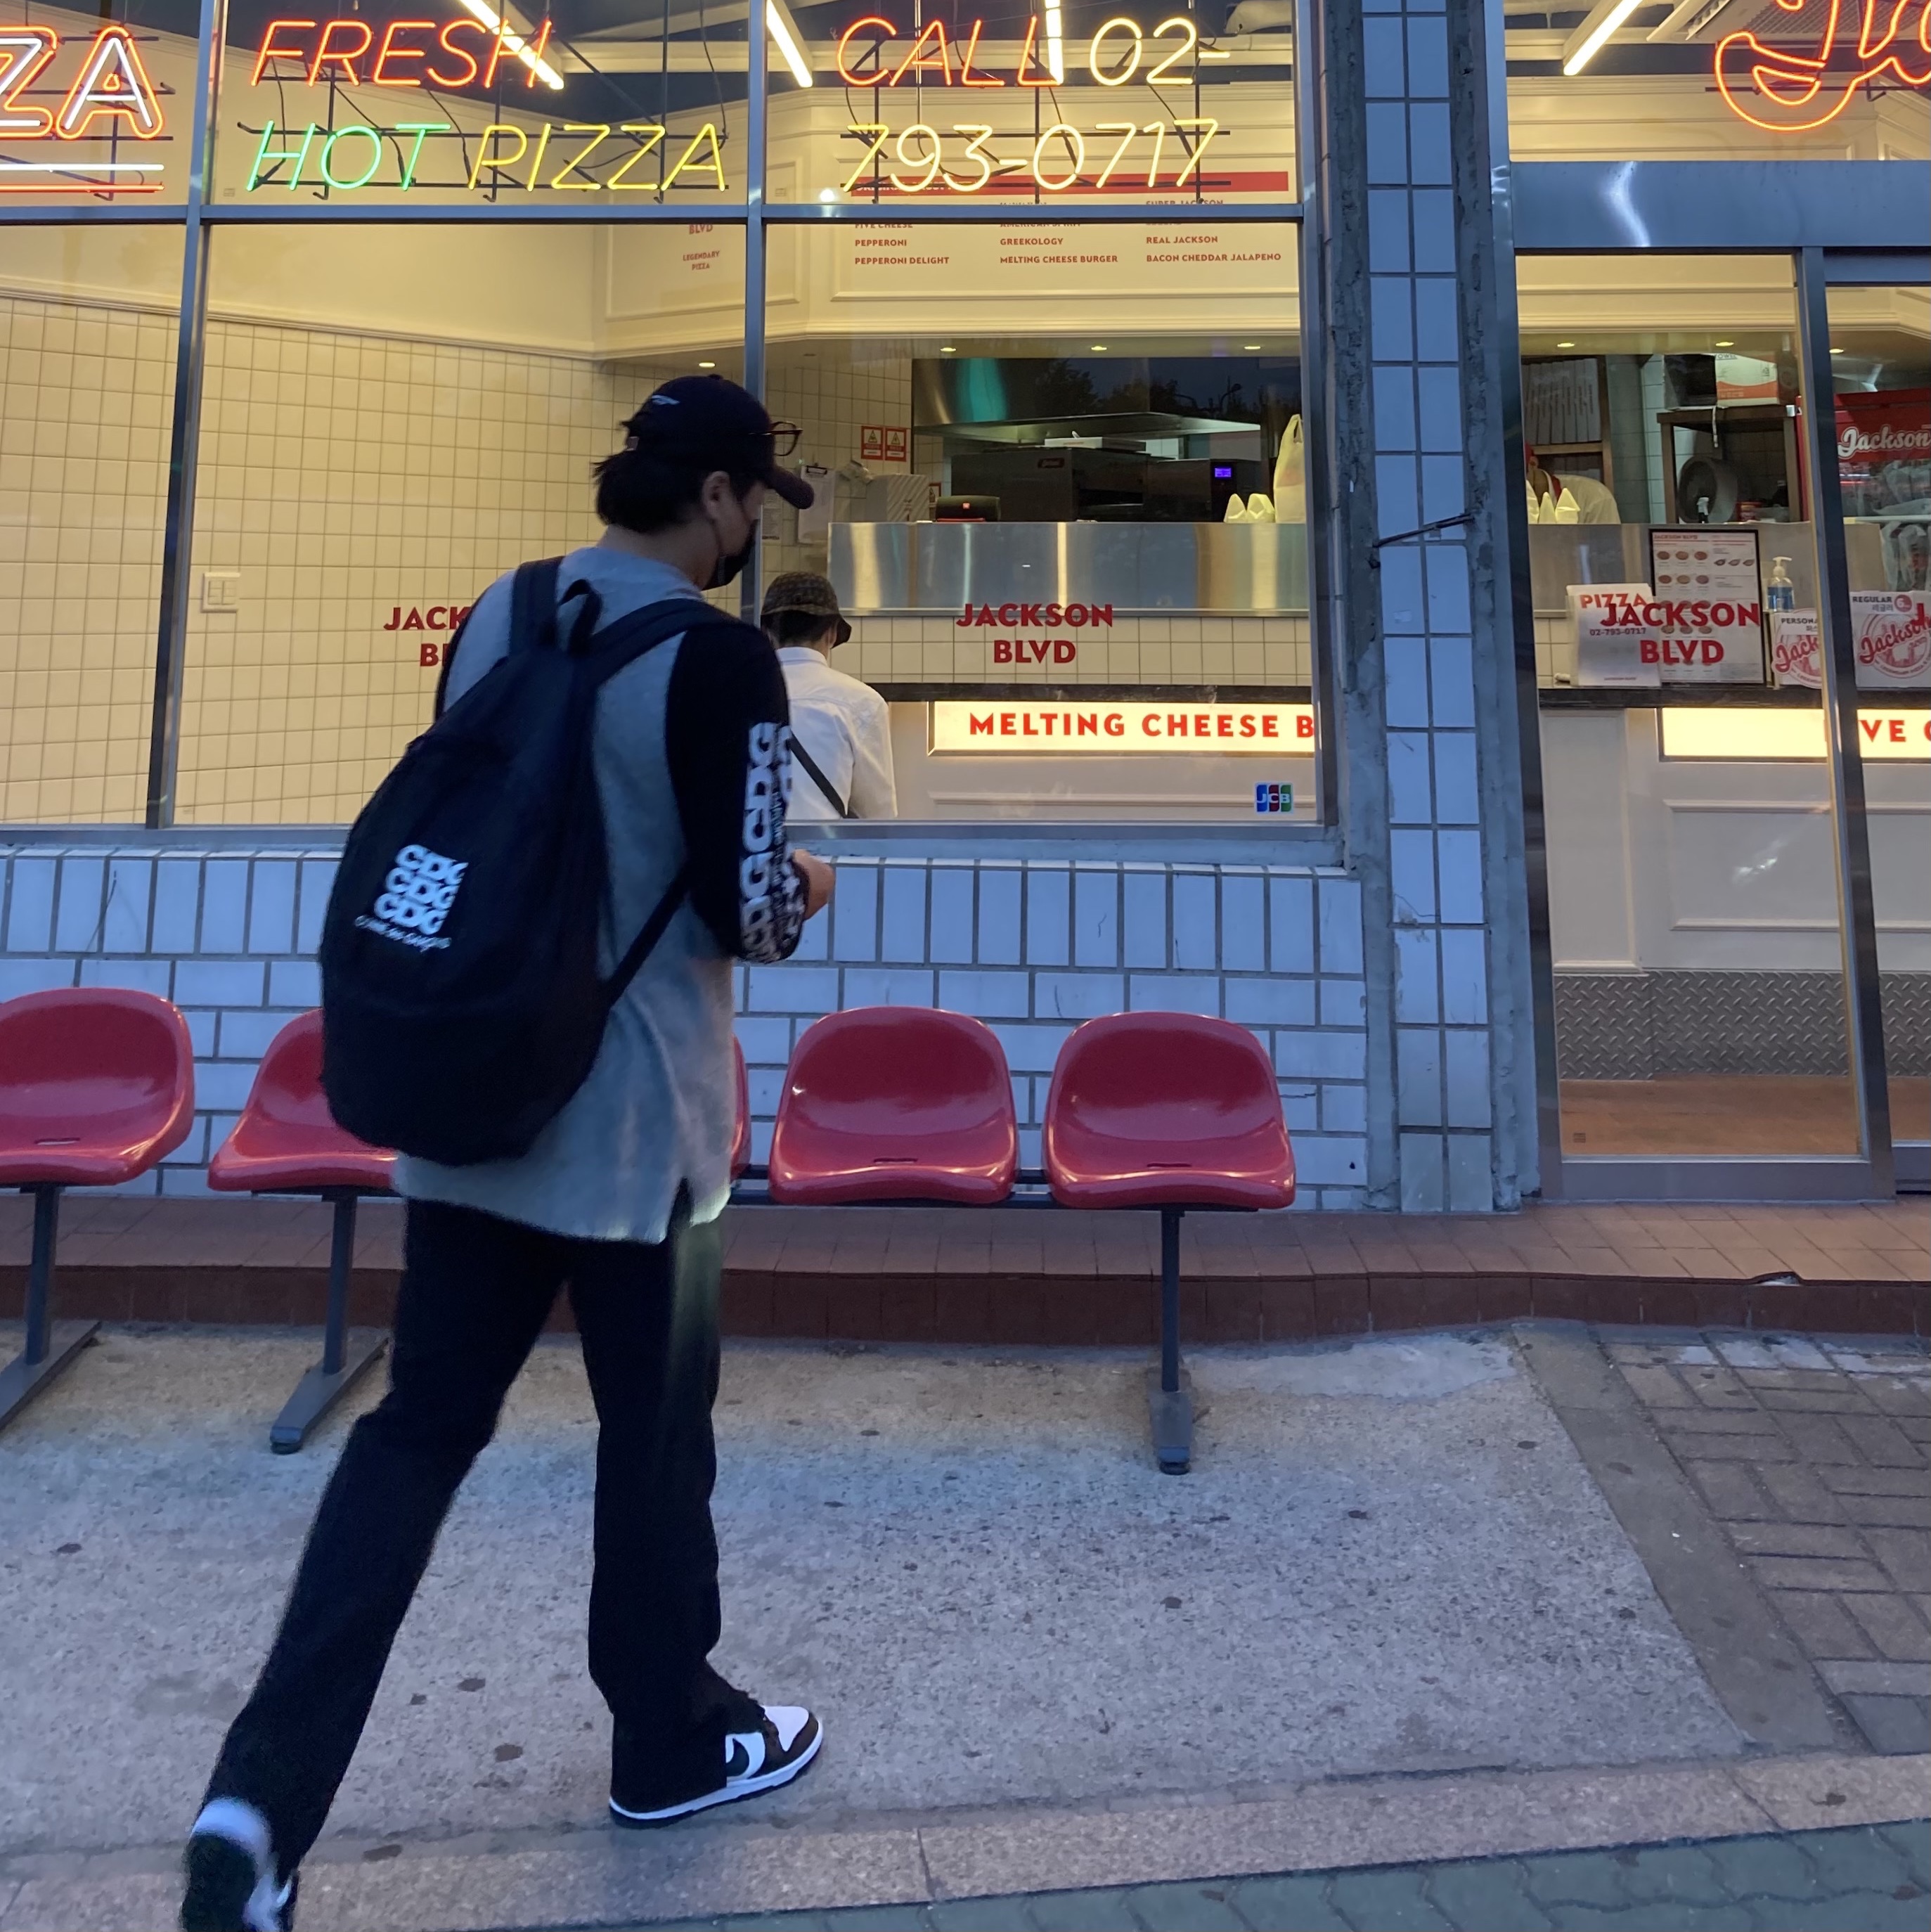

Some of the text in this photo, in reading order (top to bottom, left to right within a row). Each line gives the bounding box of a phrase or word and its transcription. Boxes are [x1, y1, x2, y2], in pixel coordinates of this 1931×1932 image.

[250, 18, 553, 89] FRESH
[837, 15, 1231, 87] CALL 02-
[246, 119, 725, 192] HOT PIZZA
[843, 117, 1218, 193] 793-0717
[683, 250, 720, 261] LEGENDARY
[1580, 593, 1647, 609] PIZZA
[956, 603, 1113, 627] JACKSON
[1600, 603, 1760, 626] JACKSON
[994, 639, 1076, 664] BLVD
[1640, 639, 1724, 664] BLVD
[969, 712, 1125, 737] MELTING
[1142, 713, 1279, 738] CHEESE
